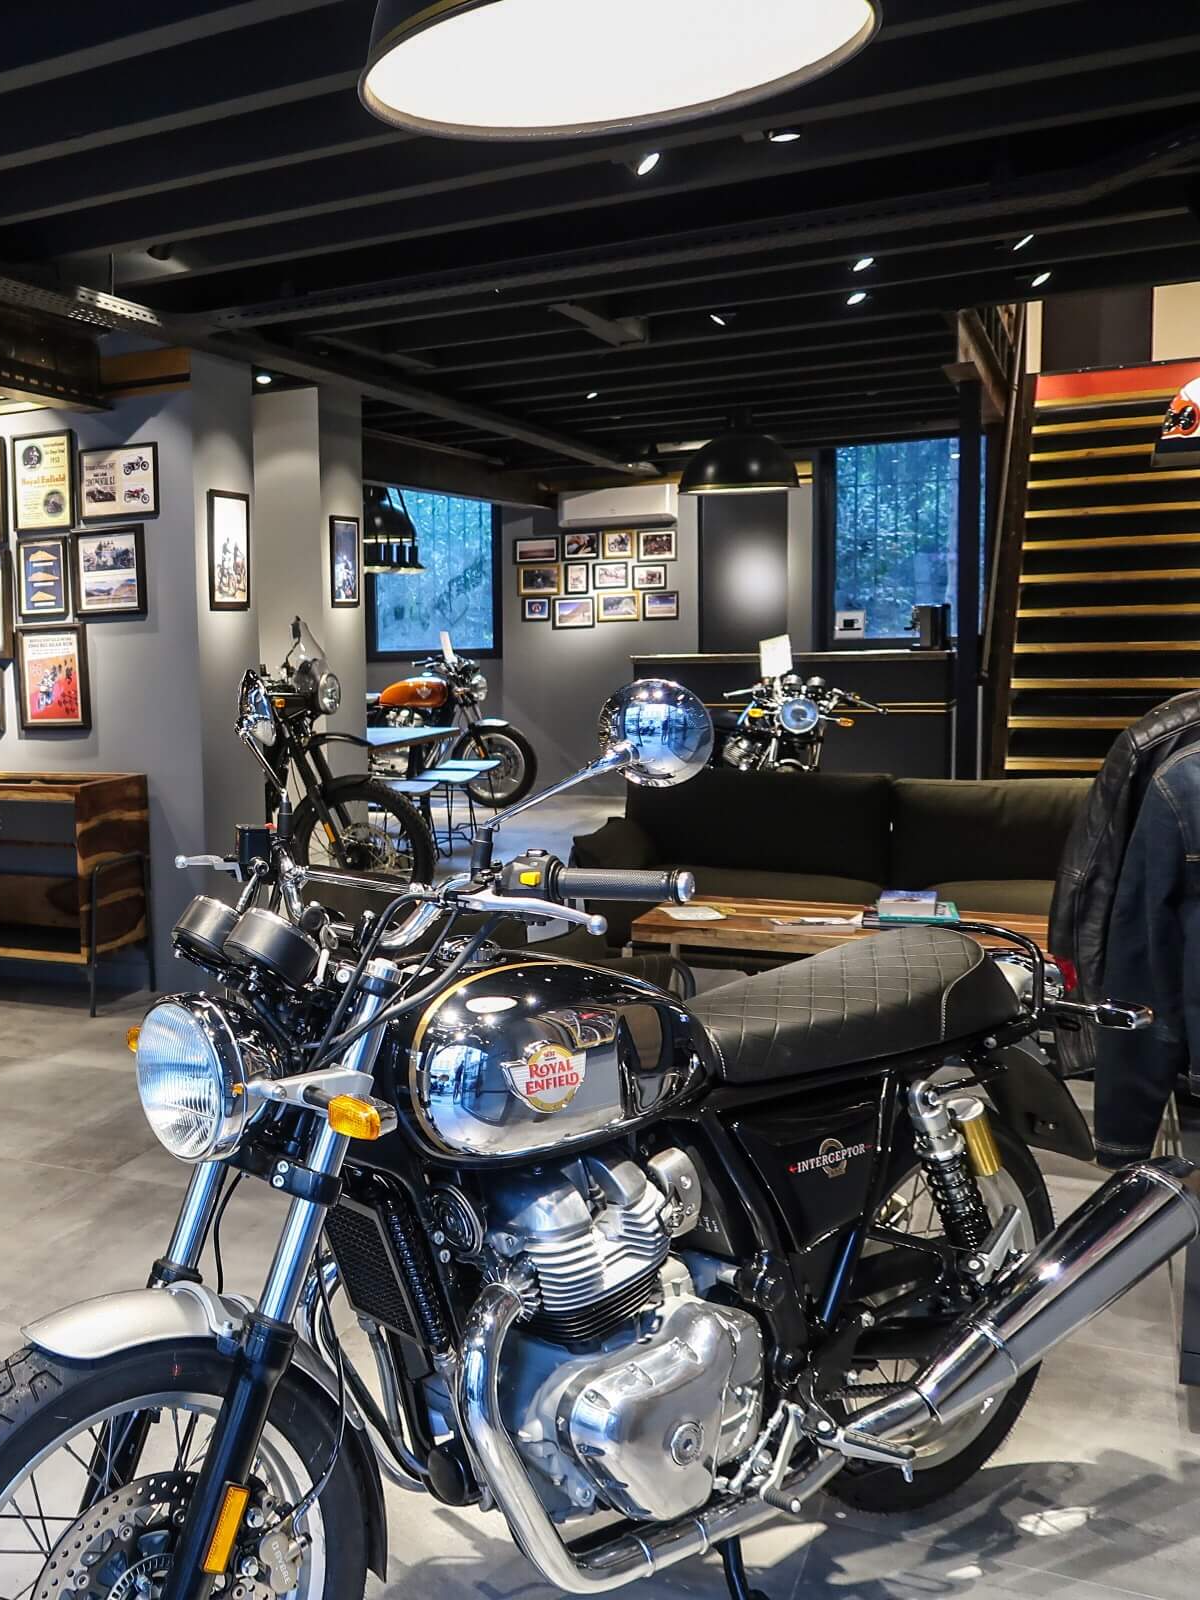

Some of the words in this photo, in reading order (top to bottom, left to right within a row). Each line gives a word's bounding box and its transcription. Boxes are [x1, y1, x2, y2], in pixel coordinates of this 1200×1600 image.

[529, 1059, 574, 1078] ROYAL
[526, 1072, 579, 1095] ENFIELD
[797, 1143, 866, 1173] INTERCEPTOR
